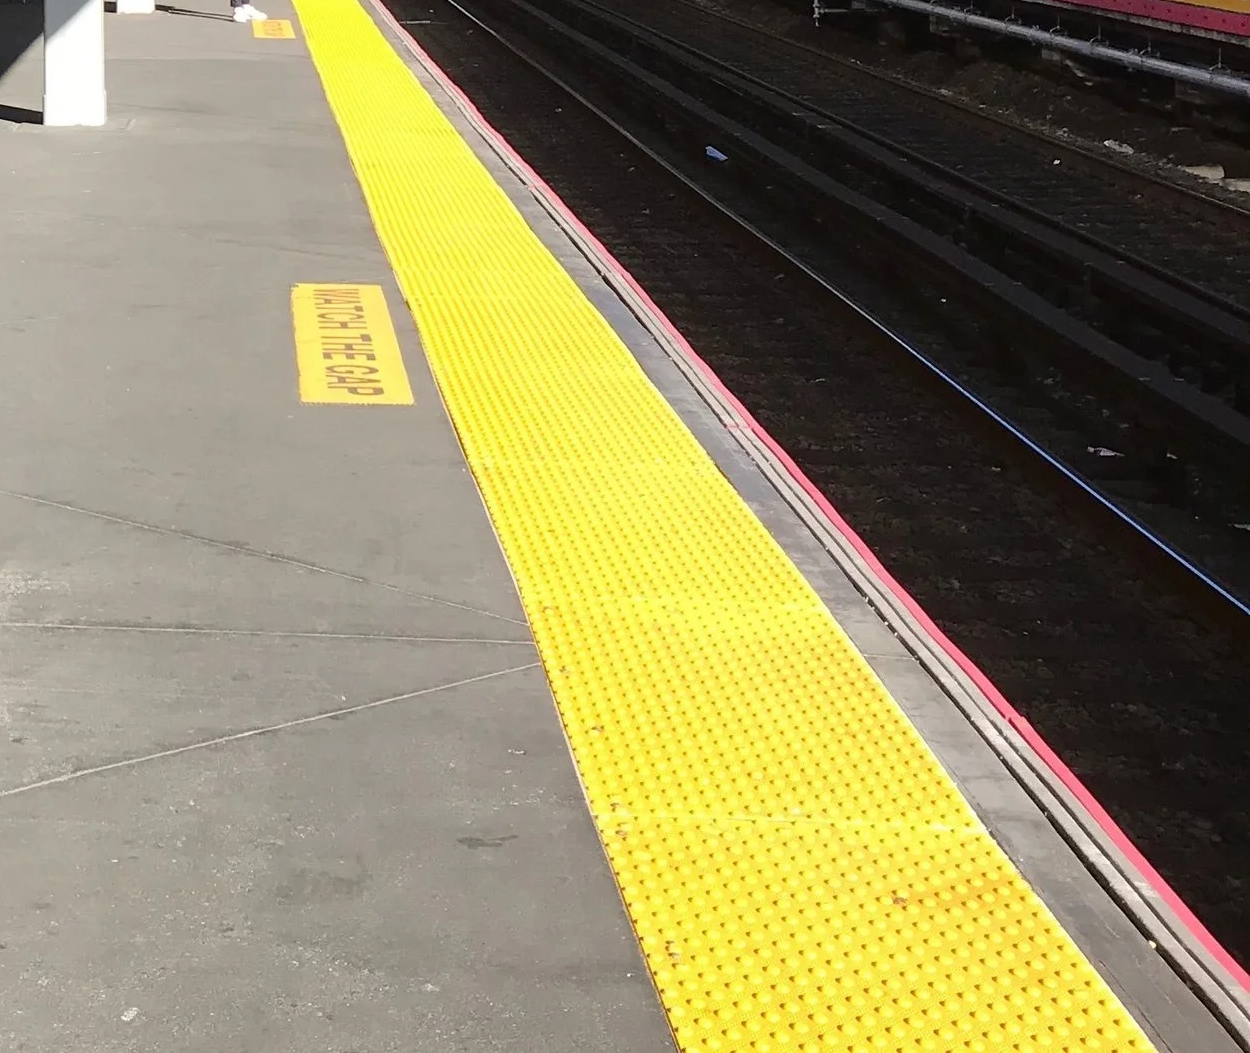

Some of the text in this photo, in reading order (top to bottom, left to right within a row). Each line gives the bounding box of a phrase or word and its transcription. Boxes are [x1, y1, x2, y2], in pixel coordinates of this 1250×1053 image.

[313, 289, 384, 395] WATCH THE GAP
